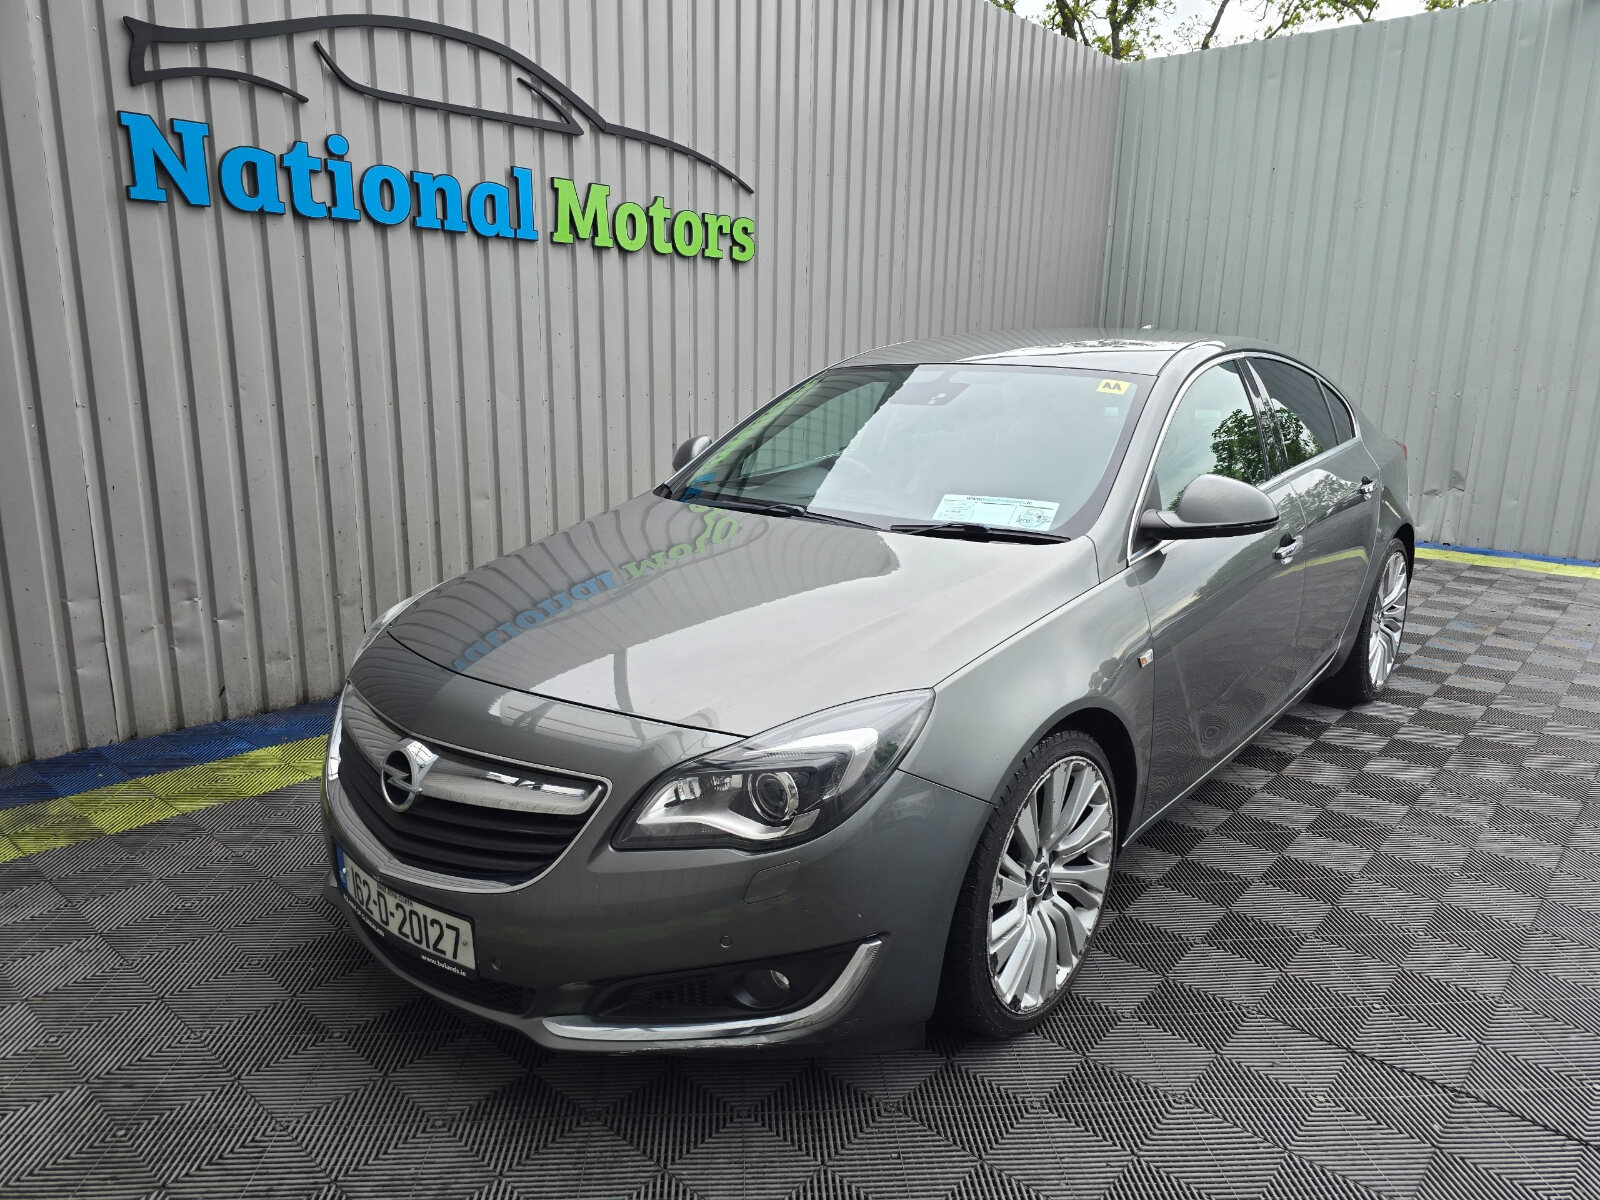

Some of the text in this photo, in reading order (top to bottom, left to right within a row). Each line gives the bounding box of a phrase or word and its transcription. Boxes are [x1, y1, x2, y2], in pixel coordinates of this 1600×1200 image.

[117, 110, 756, 263] National Motors
[1102, 381, 1122, 391] AA
[351, 866, 460, 960] 162-D-20127
